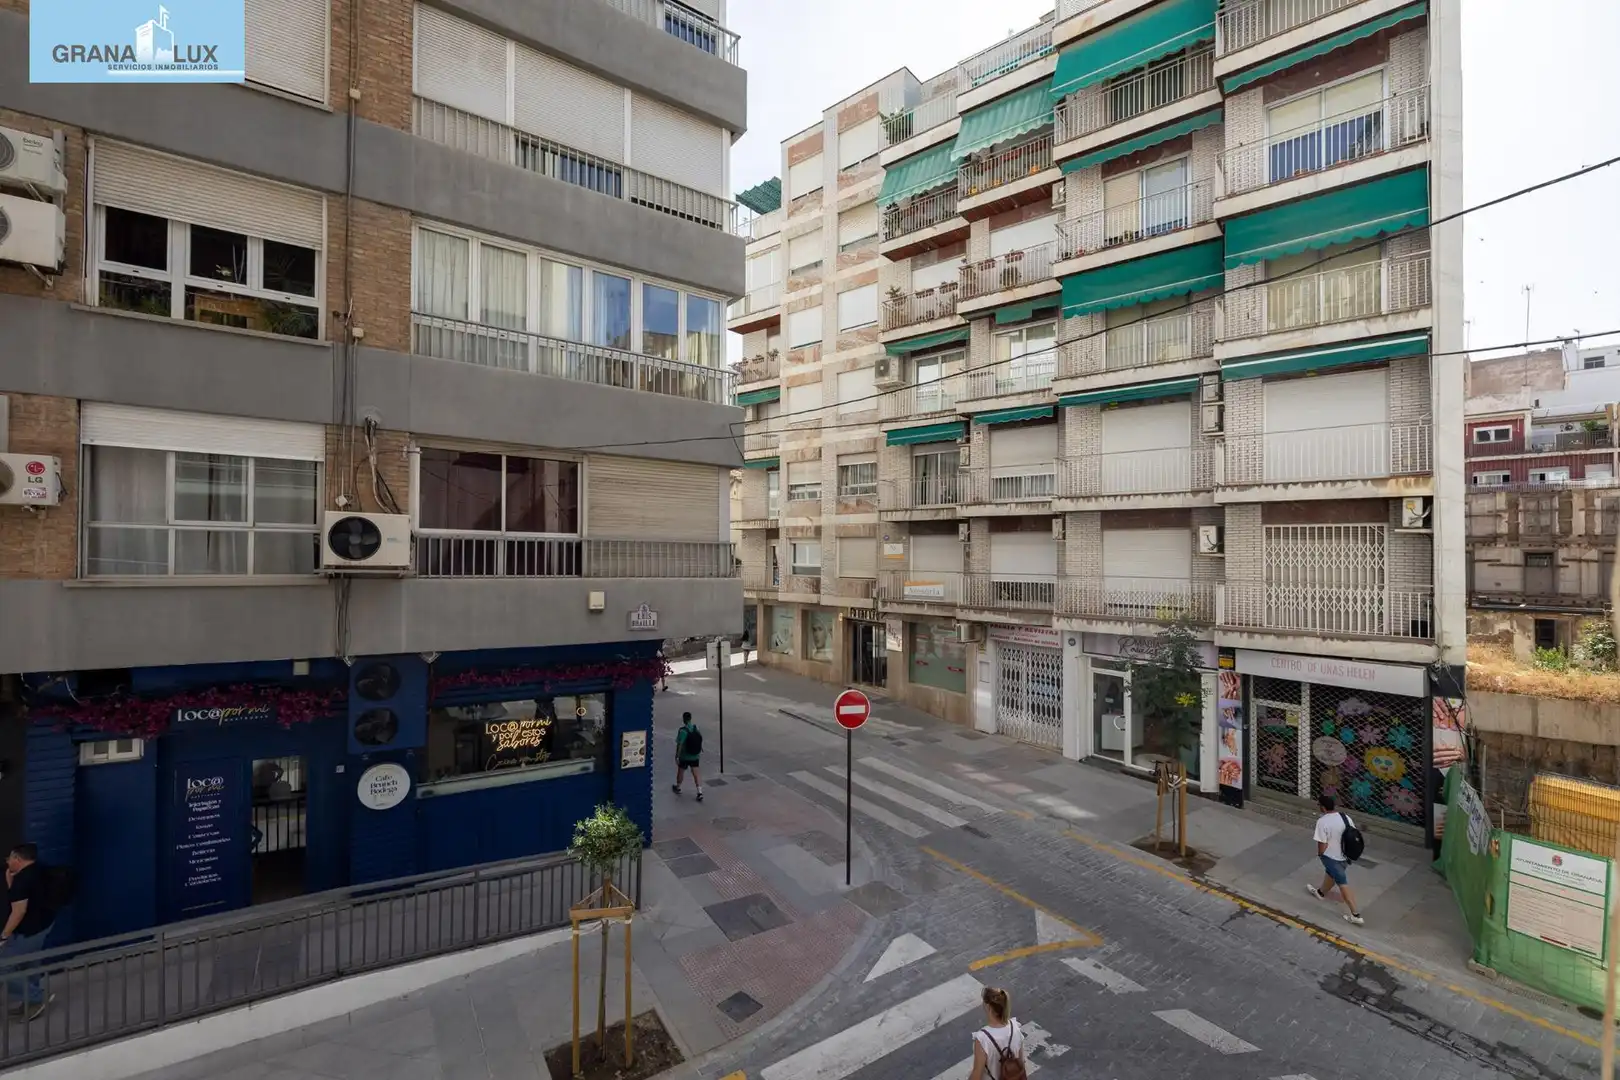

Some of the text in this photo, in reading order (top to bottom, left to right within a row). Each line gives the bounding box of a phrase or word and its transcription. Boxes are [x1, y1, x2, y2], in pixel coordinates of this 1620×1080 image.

[1270, 657, 1302, 672] CENTRO
[1308, 662, 1318, 673] DE
[1347, 666, 1376, 681] HELEN
[496, 731, 543, 751] sabores
[521, 728, 546, 738] estos
[1570, 872, 1603, 884] GRANADA
